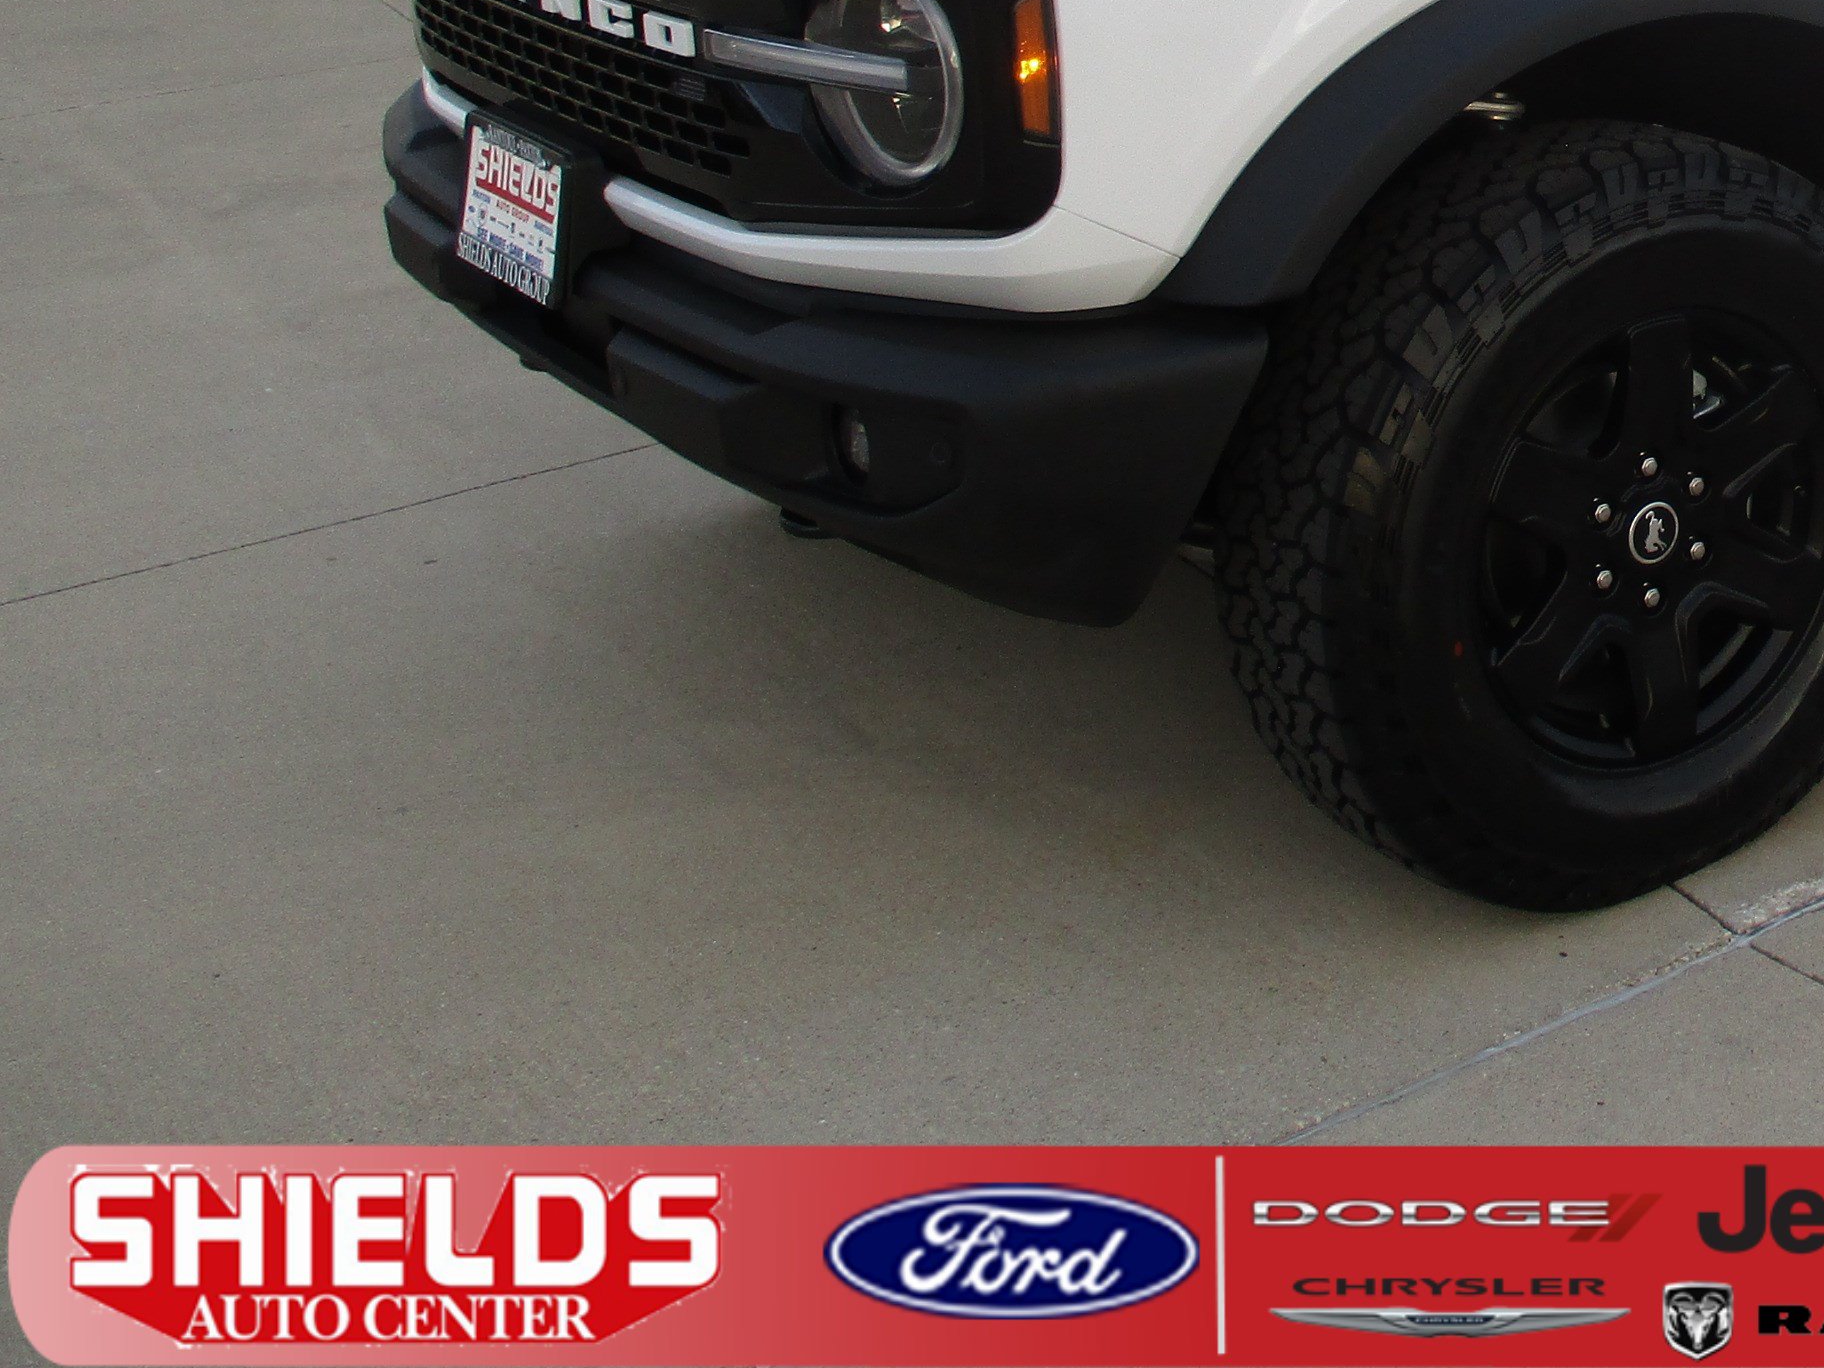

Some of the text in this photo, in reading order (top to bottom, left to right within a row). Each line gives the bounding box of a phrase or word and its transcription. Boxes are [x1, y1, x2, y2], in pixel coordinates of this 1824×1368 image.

[475, 143, 560, 215] SHIELDS
[457, 232, 550, 306] SHIELDS AUTO GROUP
